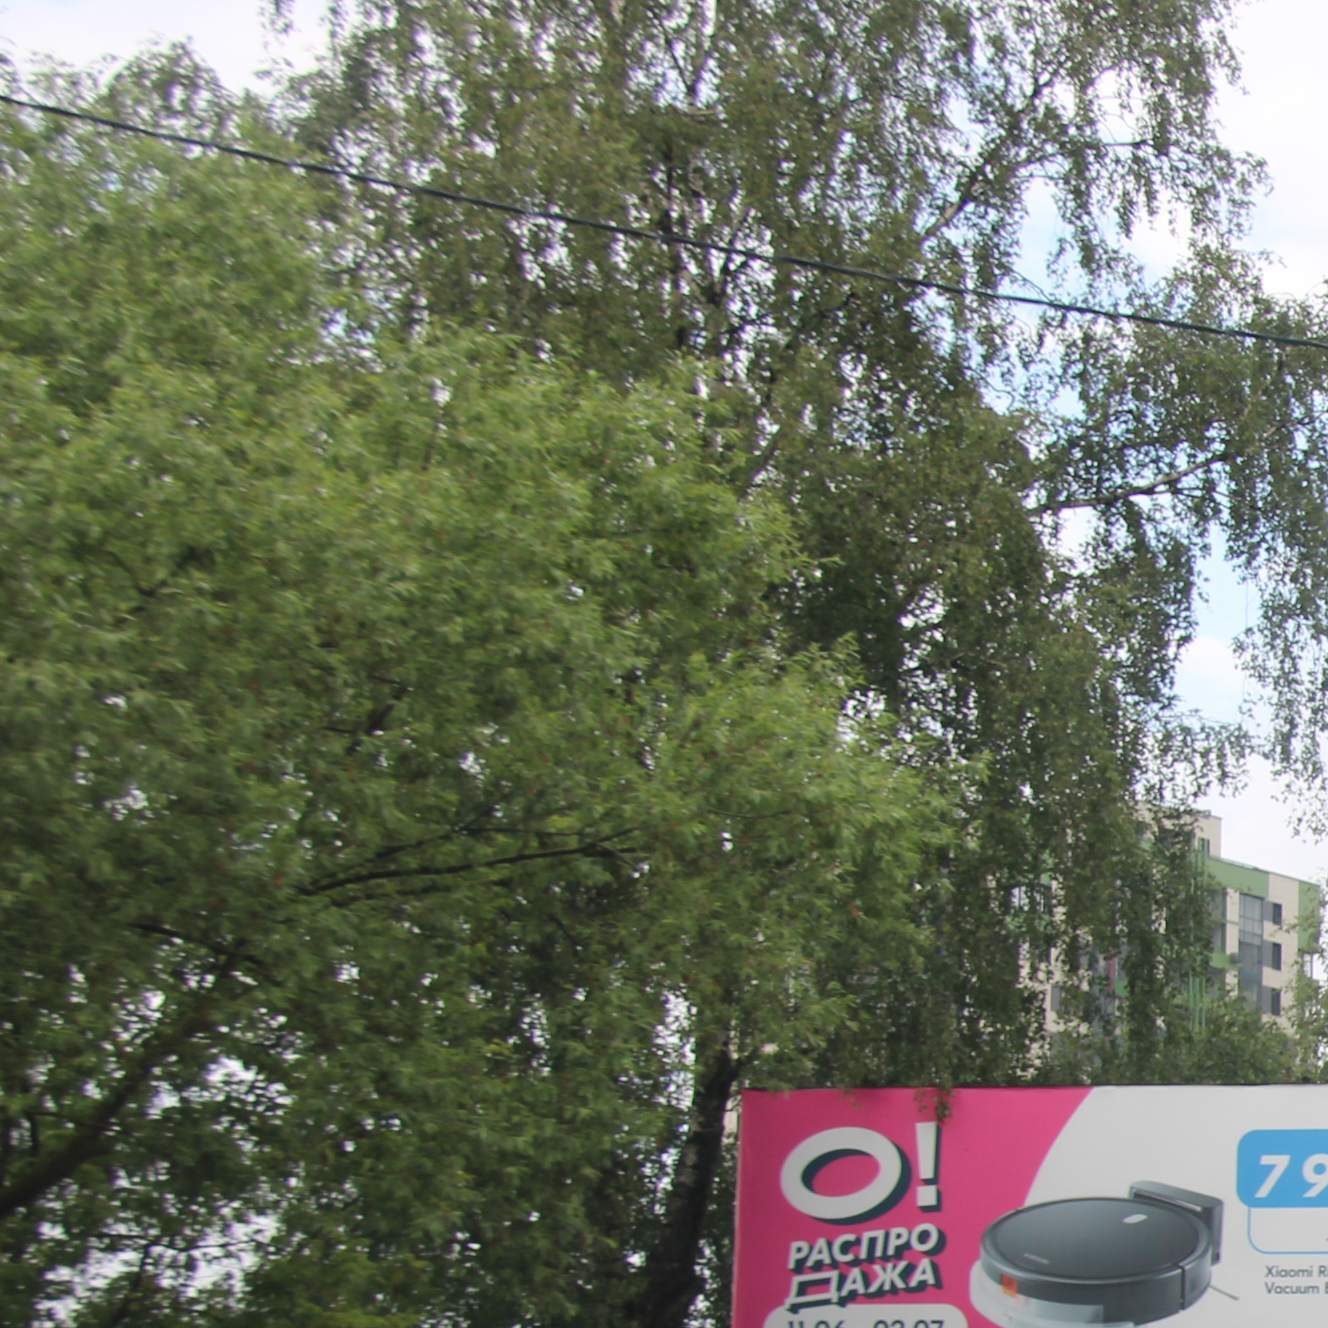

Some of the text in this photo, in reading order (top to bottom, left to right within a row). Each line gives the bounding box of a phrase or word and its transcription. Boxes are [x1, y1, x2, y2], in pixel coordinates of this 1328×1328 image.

[1254, 1154, 1291, 1198] 7
[787, 1223, 942, 1271] РАСПРО
[785, 1258, 940, 1308] ДАЖА
[1264, 1264, 1314, 1279] Xiaomi
[1264, 1280, 1321, 1295] Vacuum
